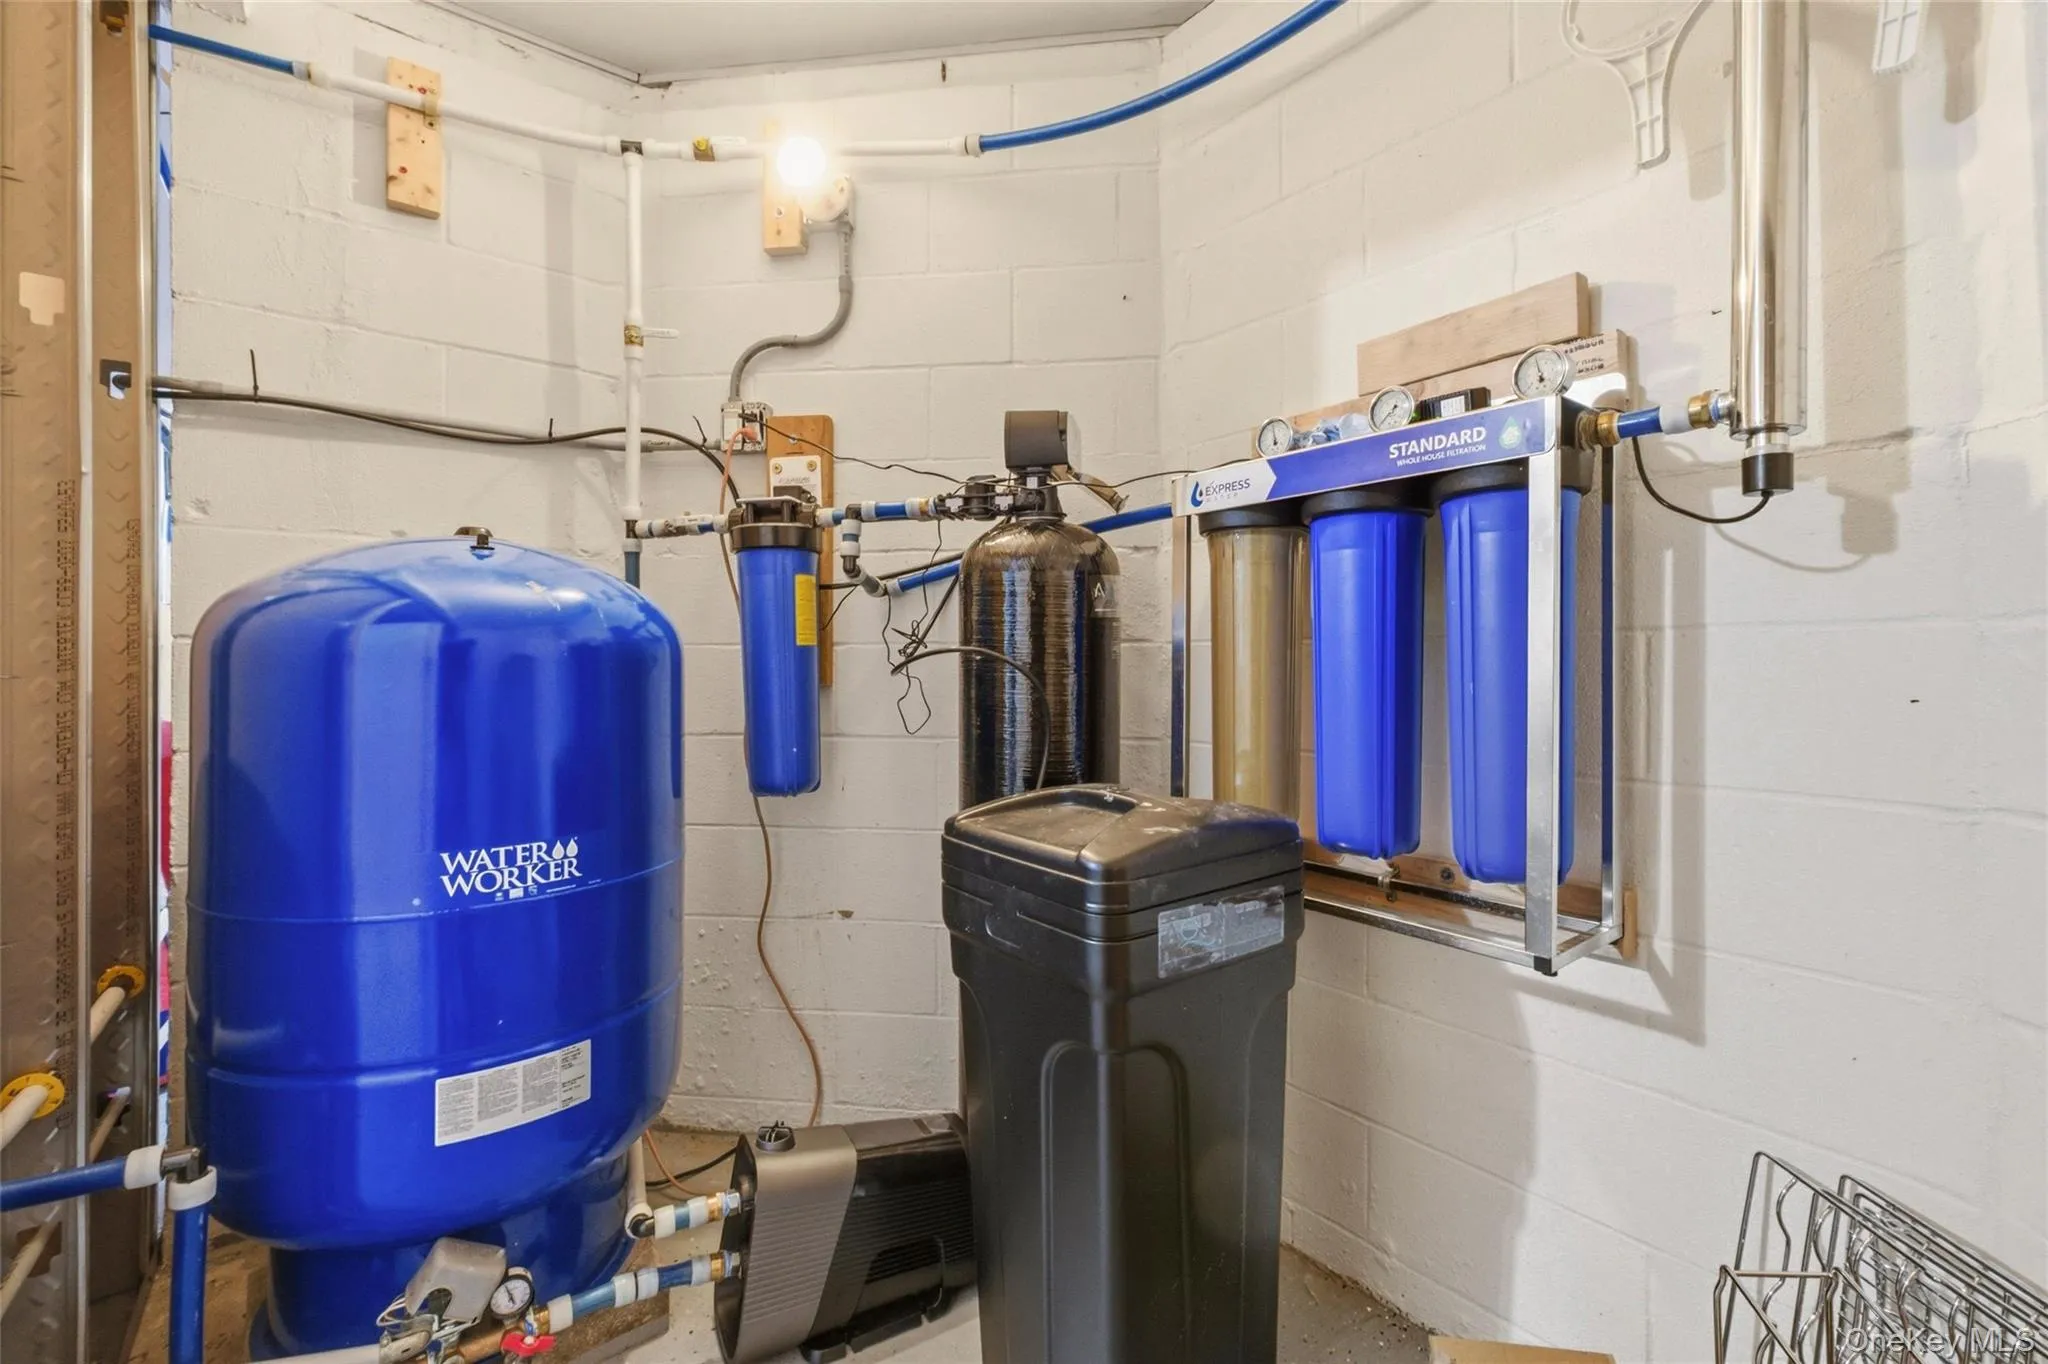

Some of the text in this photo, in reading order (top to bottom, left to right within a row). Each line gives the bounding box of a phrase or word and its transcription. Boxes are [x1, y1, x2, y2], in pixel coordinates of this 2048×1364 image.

[1389, 426, 1487, 459] STANDARD
[1396, 444, 1487, 467] WHOLE HOUSE FILTRATION
[1205, 478, 1251, 497] EXPRESS
[56, 617, 76, 673] INTERTEK
[440, 841, 553, 874] WATER
[440, 857, 583, 897] WORKER
